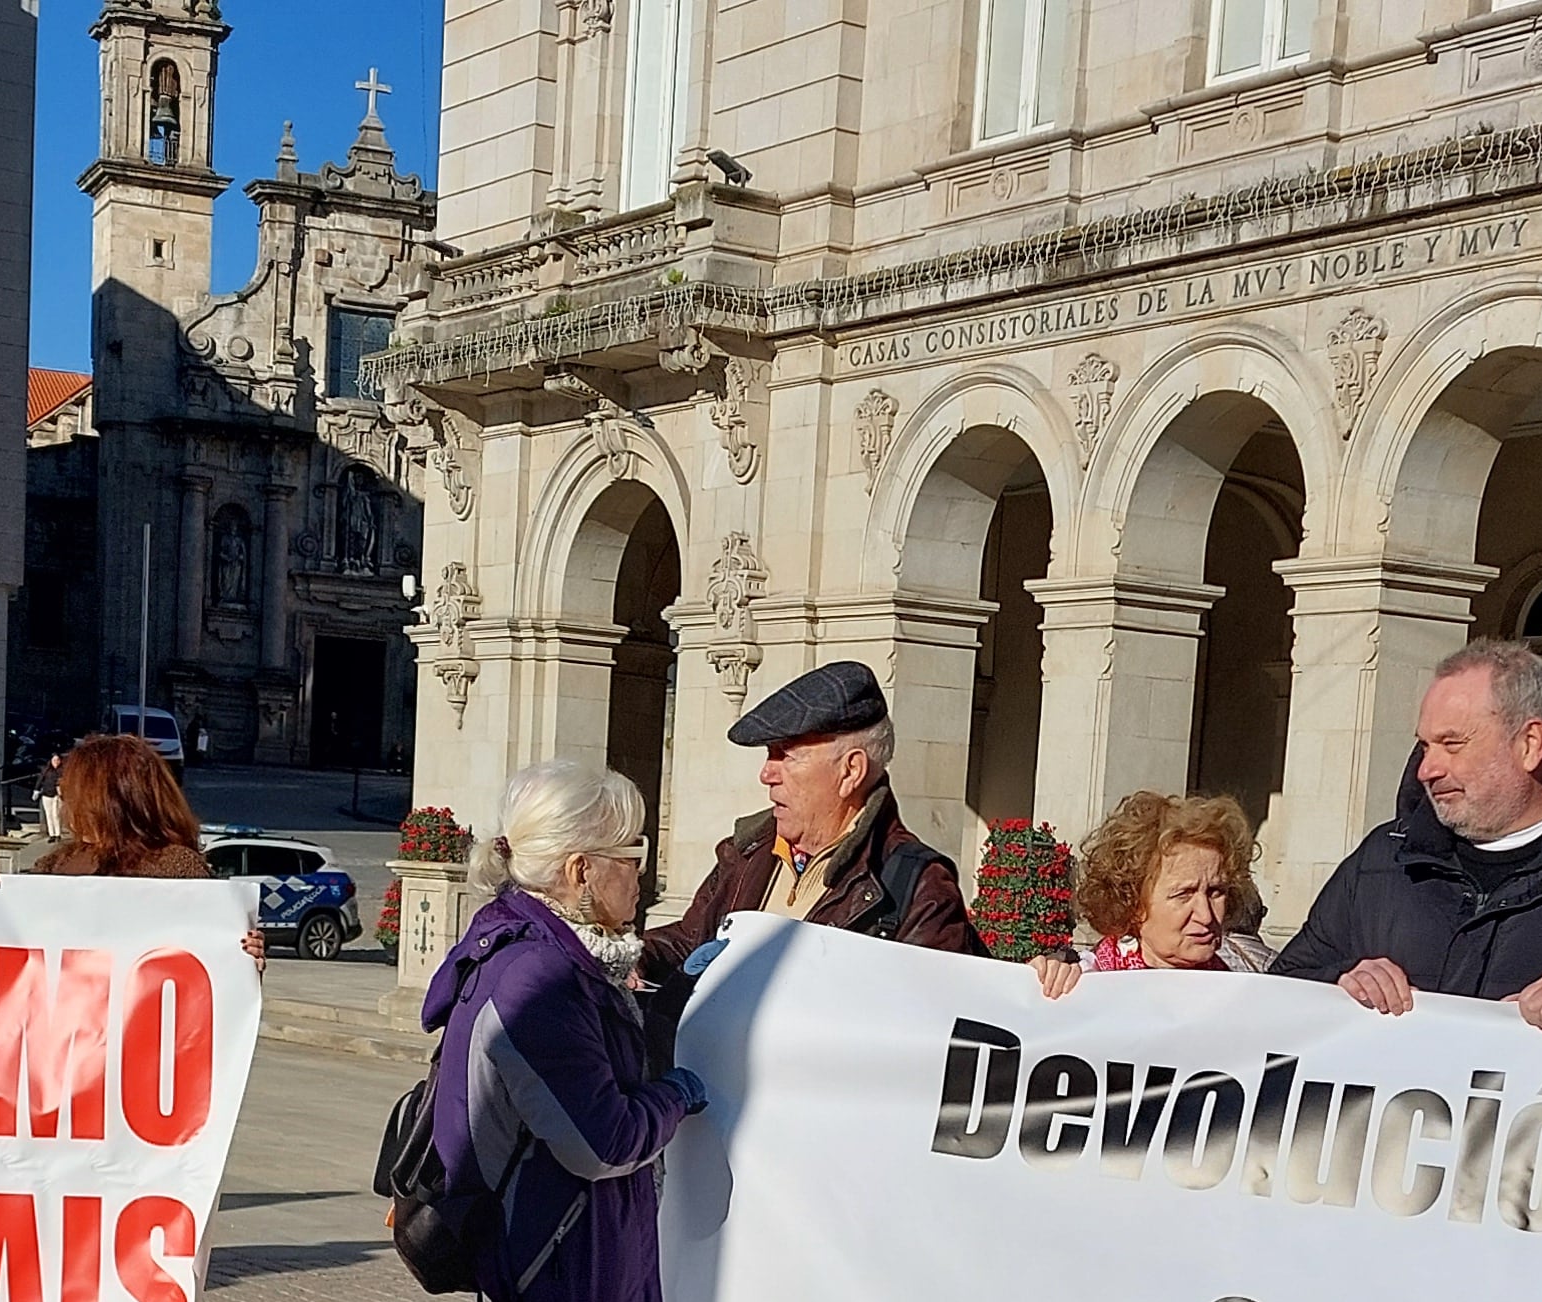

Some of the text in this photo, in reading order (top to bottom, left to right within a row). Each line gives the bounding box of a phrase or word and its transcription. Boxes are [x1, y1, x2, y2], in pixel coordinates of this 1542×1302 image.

[849, 336, 910, 367] CASAS
[926, 298, 1120, 354] CONSISTORIALES
[1137, 288, 1168, 316] DE
[1185, 279, 1215, 308] LA
[1232, 264, 1292, 298] MVY
[1309, 242, 1405, 285] NOBLE
[1424, 236, 1443, 264] Y
[1459, 218, 1530, 258] MVY
